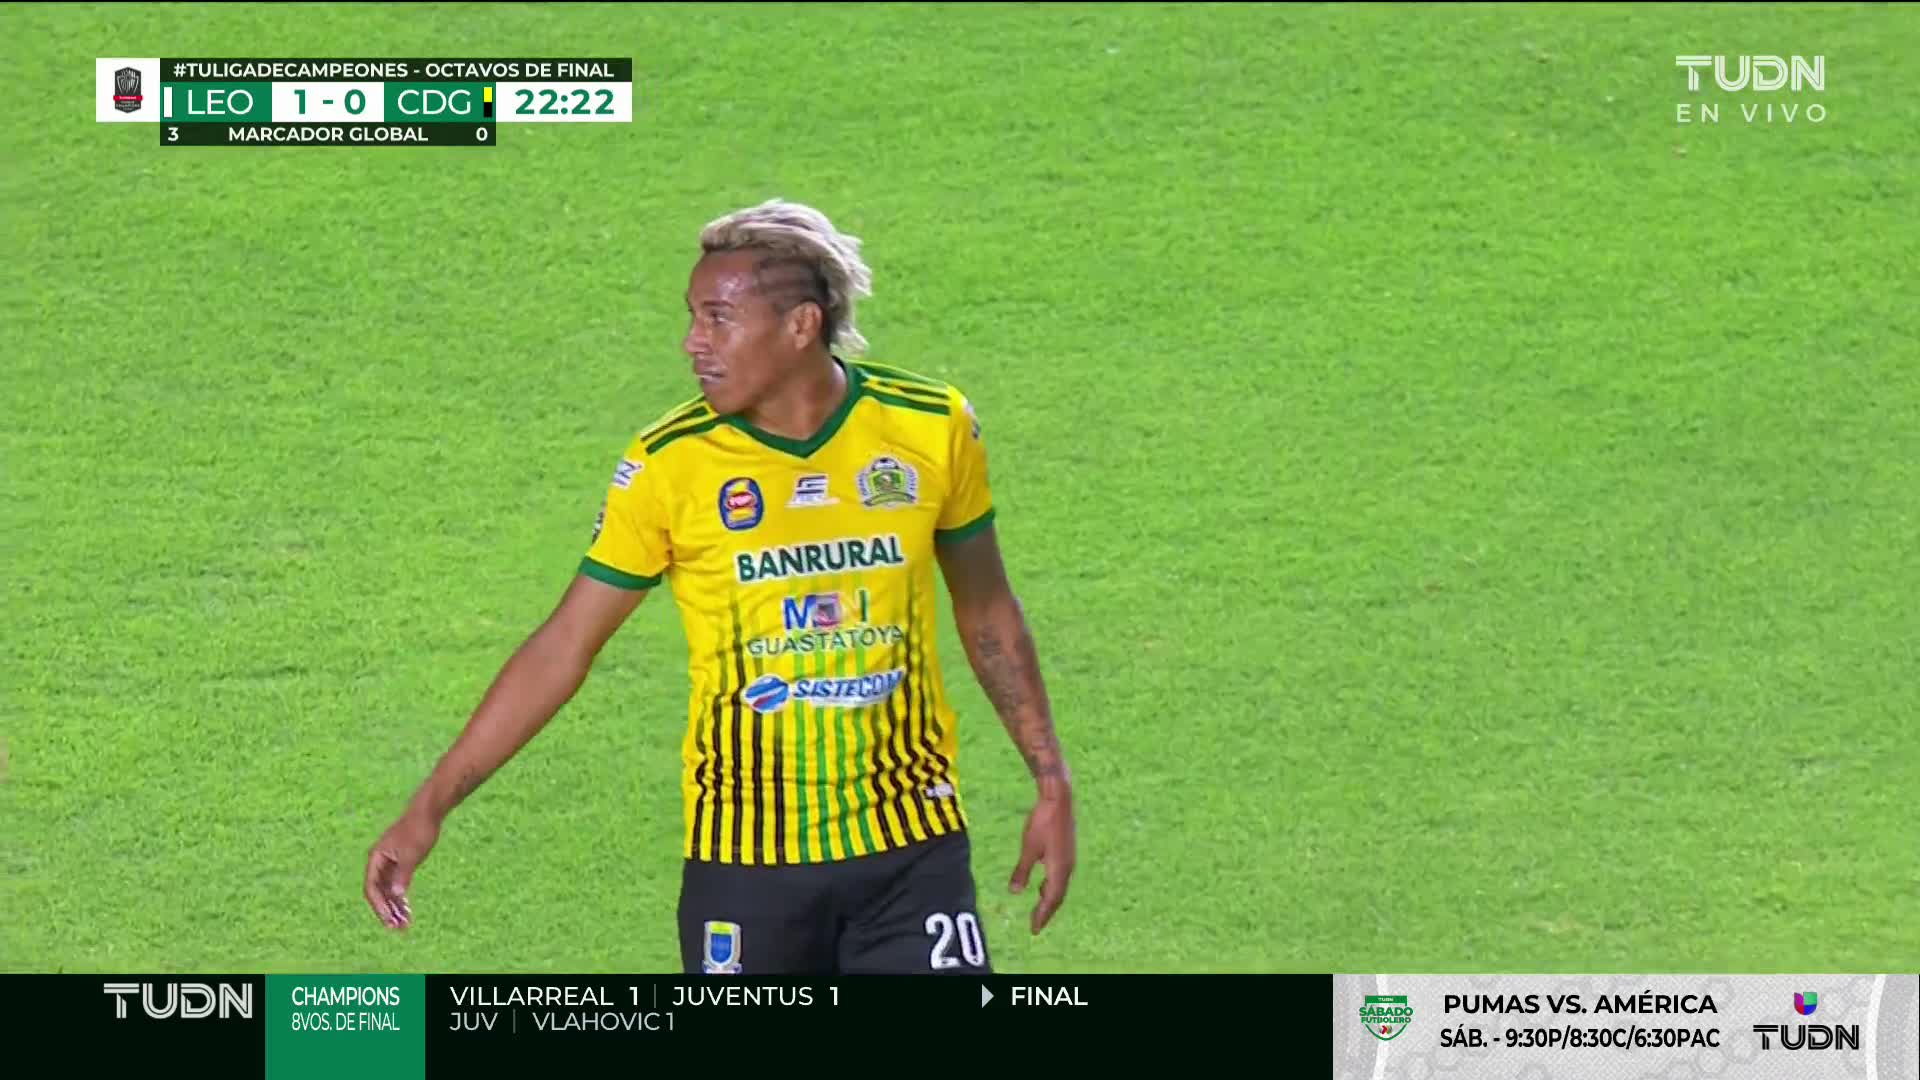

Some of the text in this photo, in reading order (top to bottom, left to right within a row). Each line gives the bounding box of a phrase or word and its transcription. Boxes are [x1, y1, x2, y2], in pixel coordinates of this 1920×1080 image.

[736, 535, 904, 581] BANRURAL
[748, 624, 904, 656] GUASTATOYA
[925, 912, 985, 970] 20
